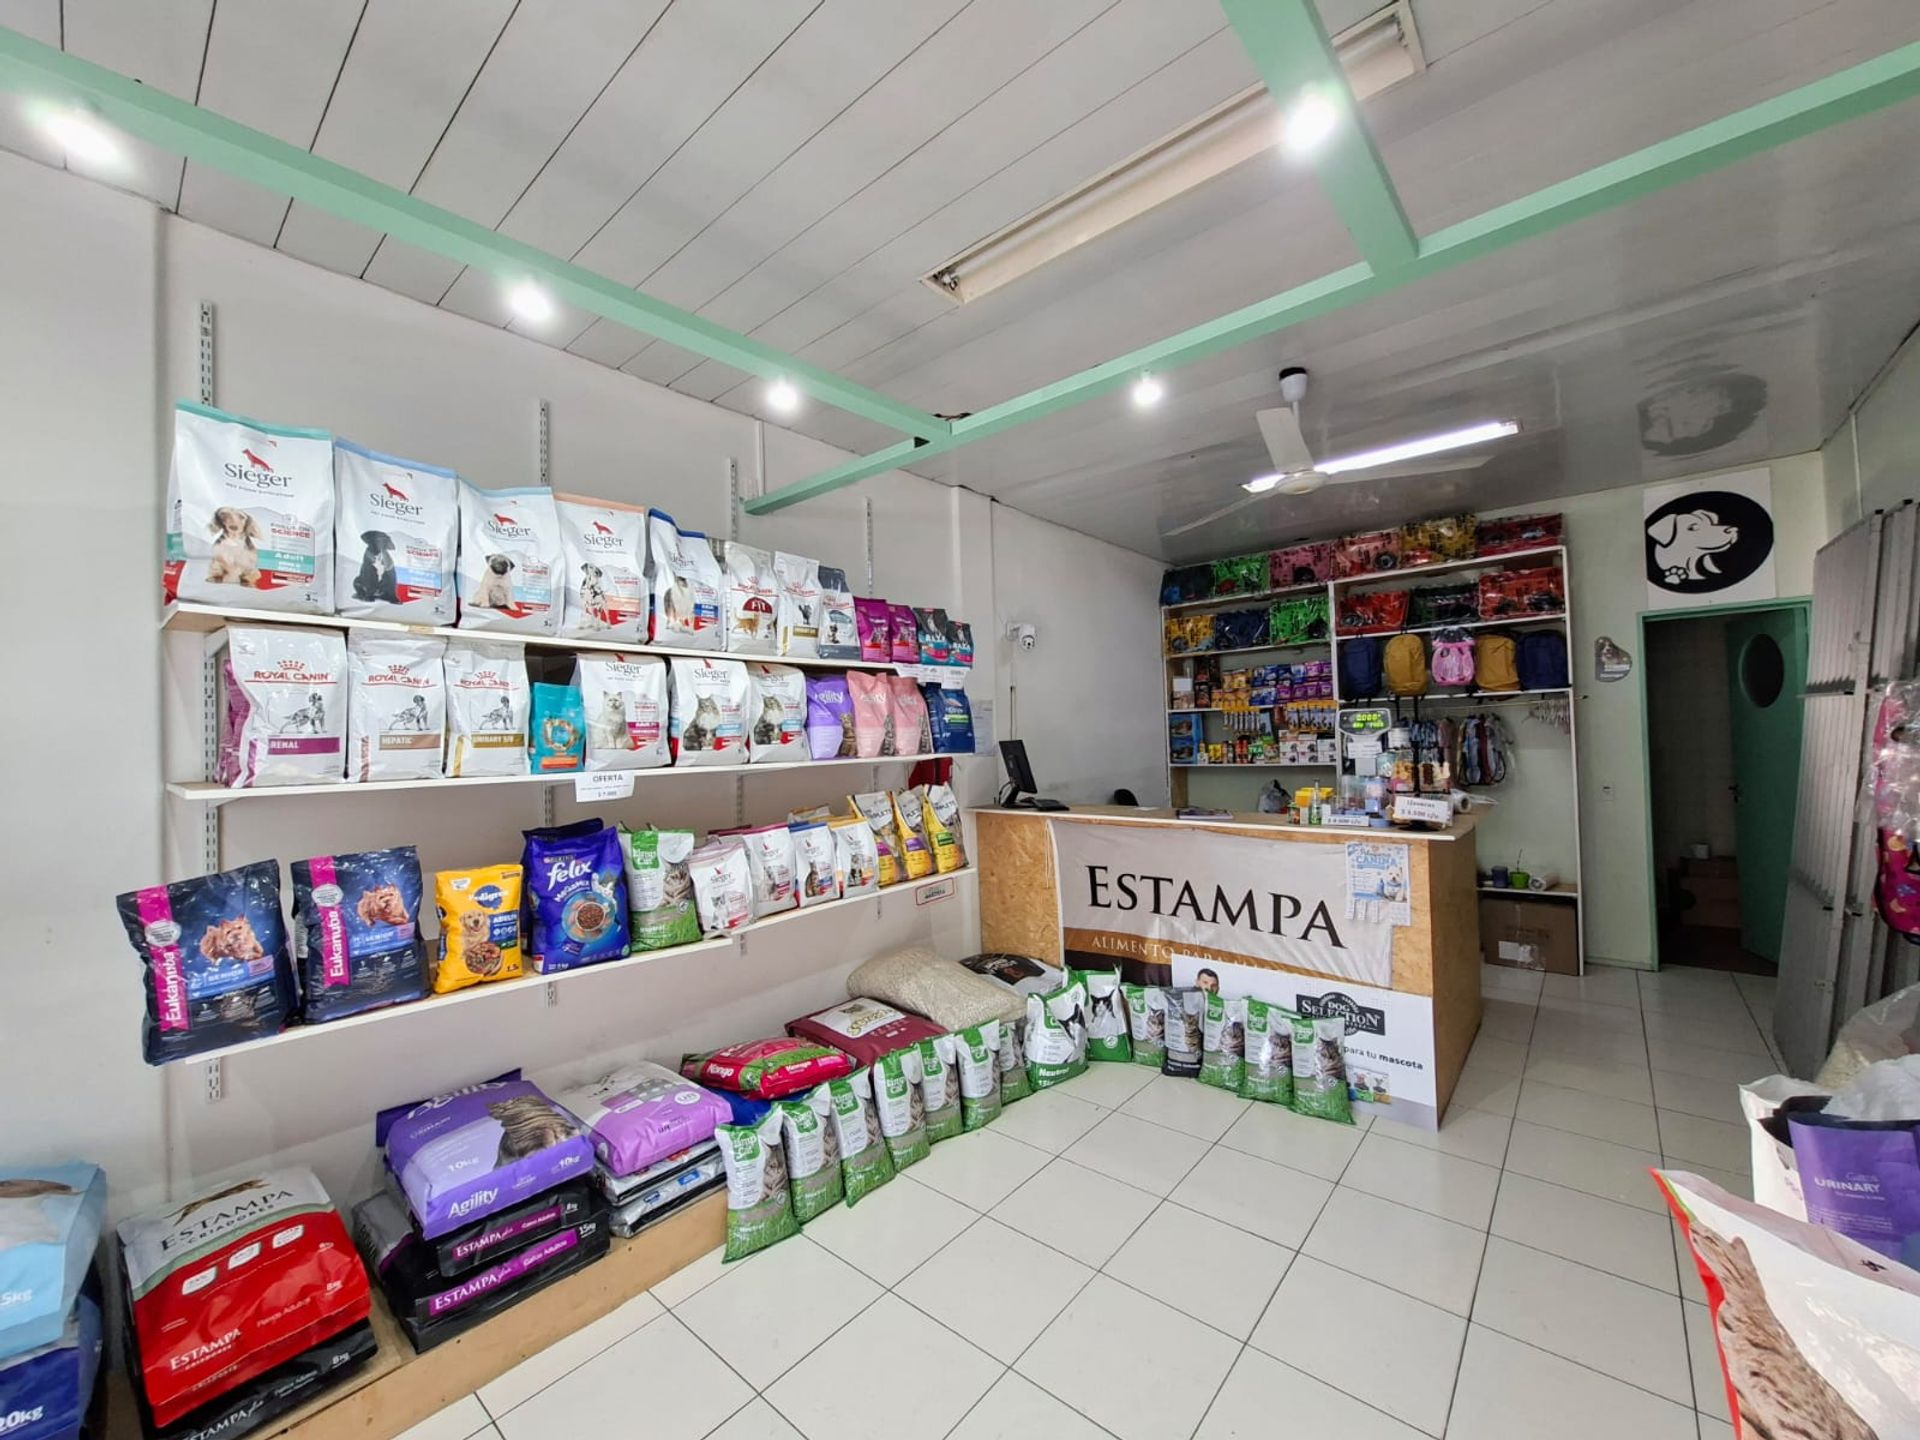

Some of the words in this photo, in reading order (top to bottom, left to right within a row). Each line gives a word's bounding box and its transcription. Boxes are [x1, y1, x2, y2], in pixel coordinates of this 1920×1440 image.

[224, 462, 292, 489] Sieger
[369, 492, 424, 516] Sieger
[487, 519, 531, 538] Sieger
[583, 533, 624, 549] Sieger
[253, 670, 290, 680] ROYAL
[293, 672, 329, 681] CANIN
[368, 675, 397, 683] ROYAL
[605, 661, 642, 677] Sieger
[694, 667, 728, 680] Sieger
[270, 740, 299, 749] RENAL
[381, 736, 413, 745] HEPATIC
[592, 773, 623, 783] OFERTA
[547, 860, 592, 891] felix
[1085, 865, 1349, 949] ESTAMPA
[329, 910, 344, 978] Eukanuba
[1092, 935, 1175, 959] ALIMENTO
[165, 950, 183, 1022] Eukanuba
[1301, 999, 1381, 1028] SELECTION
[1328, 1001, 1350, 1012] DOG
[1343, 1045, 1364, 1055] para
[1366, 1050, 1377, 1059] tu
[1379, 1054, 1424, 1070] mascota
[1814, 1176, 1880, 1193] URINARY
[448, 1188, 498, 1219] Agility
[161, 1190, 294, 1251] ESTAMPA
[456, 1232, 501, 1257] ESTAMPA
[434, 1274, 497, 1310] ESTAMPA
[169, 1327, 241, 1371] ESTAMPA
[183, 1410, 248, 1440] STAMPA
